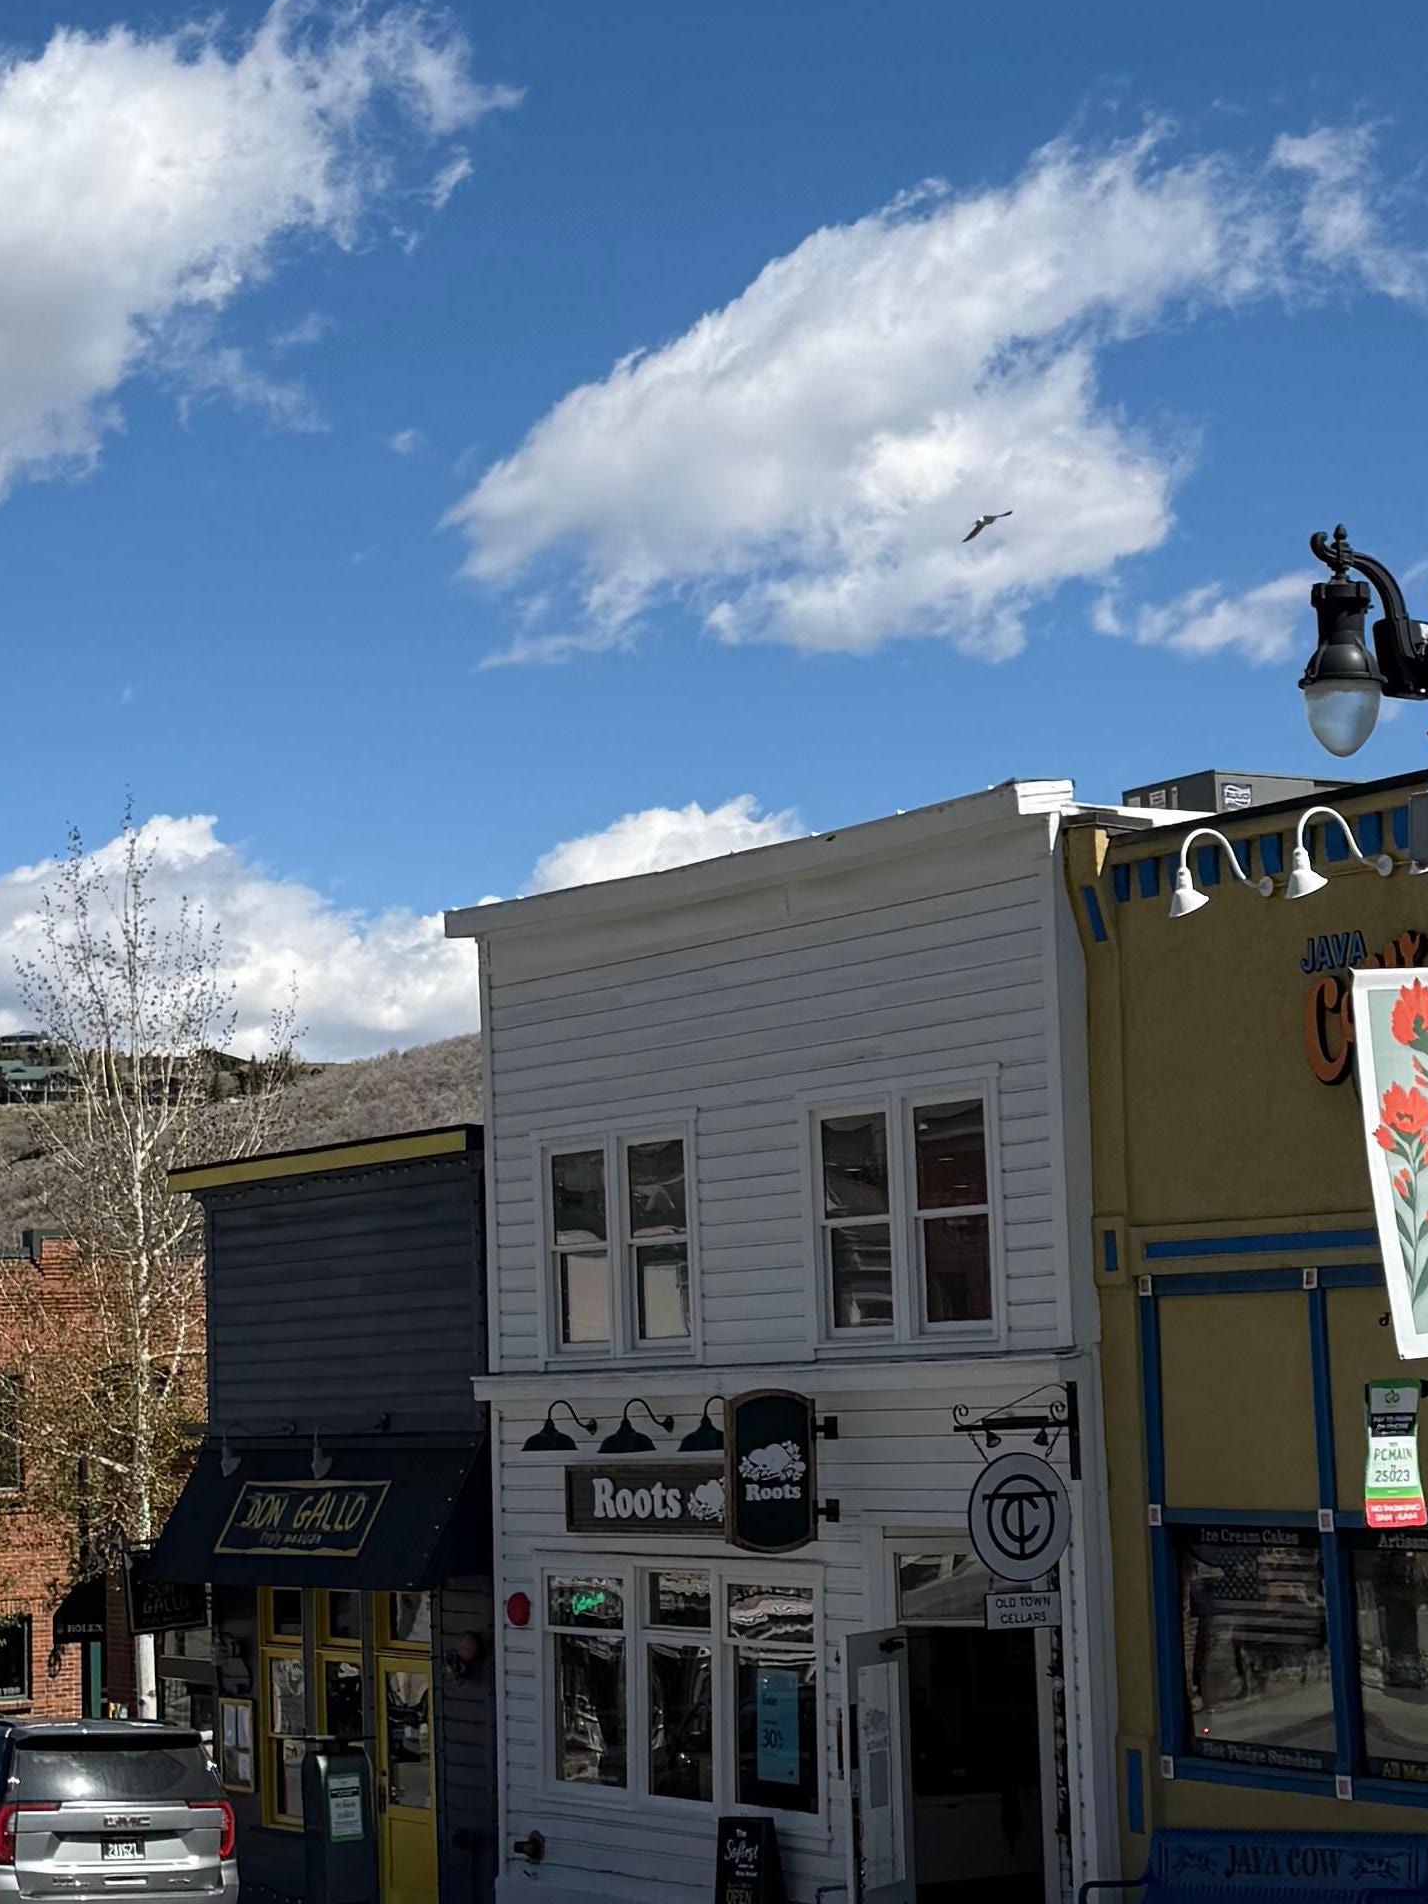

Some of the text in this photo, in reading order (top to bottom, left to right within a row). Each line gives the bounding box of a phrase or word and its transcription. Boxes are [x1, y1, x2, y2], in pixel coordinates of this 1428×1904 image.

[1300, 930, 1367, 973] JAVA
[1373, 1448, 1412, 1461] PCMAIN
[1375, 1469, 1410, 1482] 25023
[592, 1477, 682, 1519] Roots
[745, 1484, 802, 1501] Roots
[236, 1491, 369, 1531] DON GALLO
[1200, 1527, 1299, 1545] Ice Cream Cakes
[996, 1597, 1051, 1608] OLD TOWN
[1000, 1612, 1047, 1624] CELLARS
[1228, 1746, 1266, 1766] Fudge
[1267, 1750, 1323, 1769] Sundaes
[1382, 1762, 1400, 1778] All
[103, 1814, 151, 1827] GMC
[1225, 1846, 1343, 1878] JAVA COW
